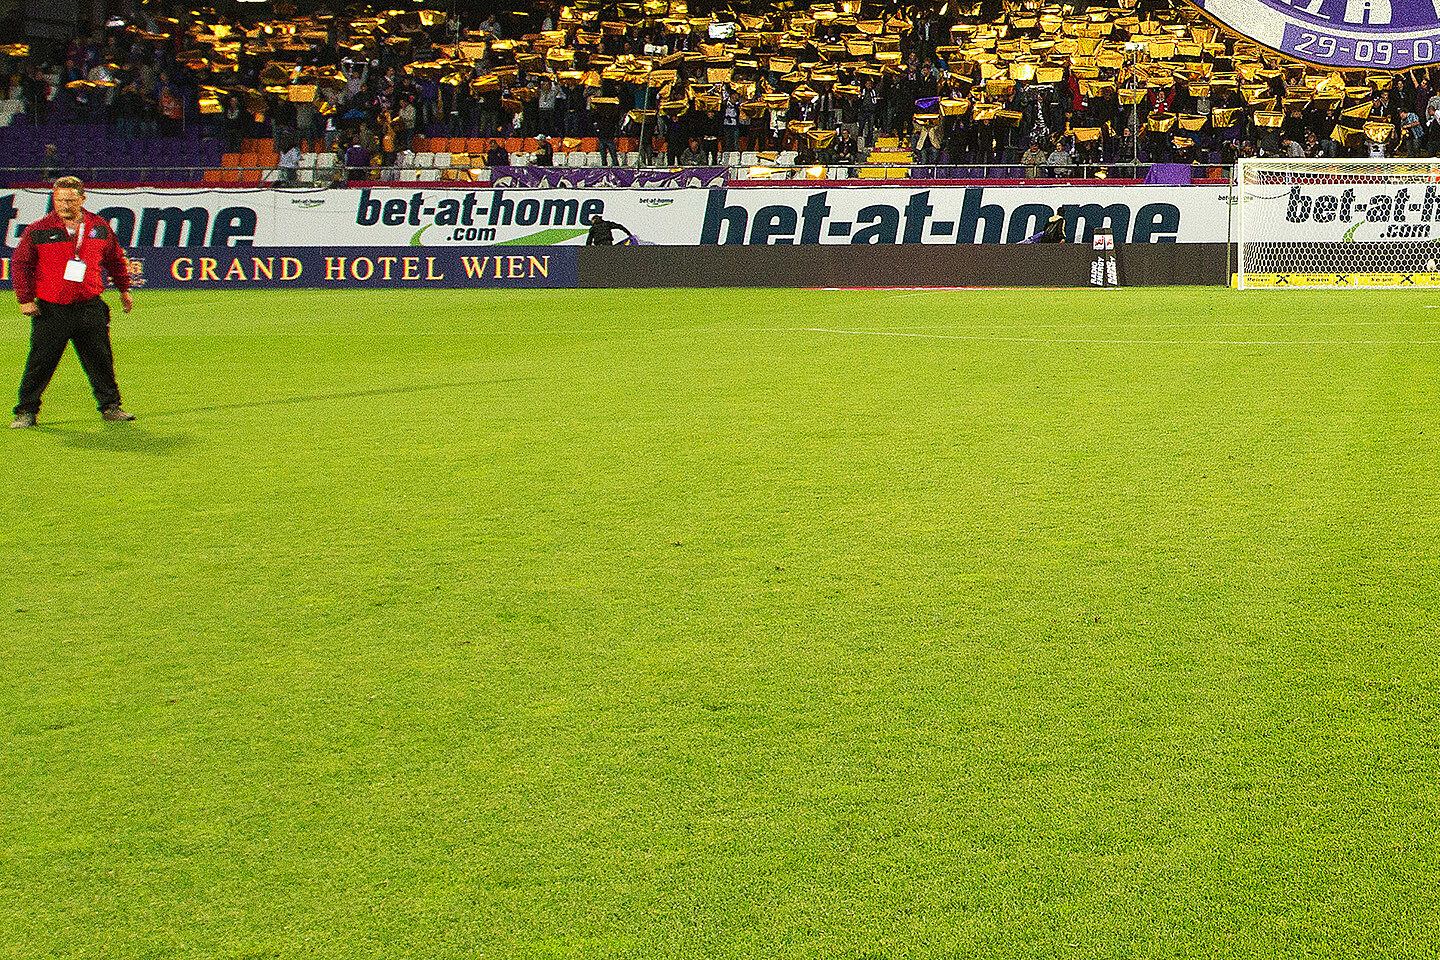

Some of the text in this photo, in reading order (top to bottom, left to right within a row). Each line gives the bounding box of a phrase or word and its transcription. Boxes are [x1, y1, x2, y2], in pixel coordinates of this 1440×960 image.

[356, 189, 605, 227] bet-at-home
[700, 189, 1181, 244] bet-at-home
[446, 227, 497, 242] .com
[1380, 224, 1431, 239] .com
[171, 255, 550, 281] GRAND HOTEL WIEN
